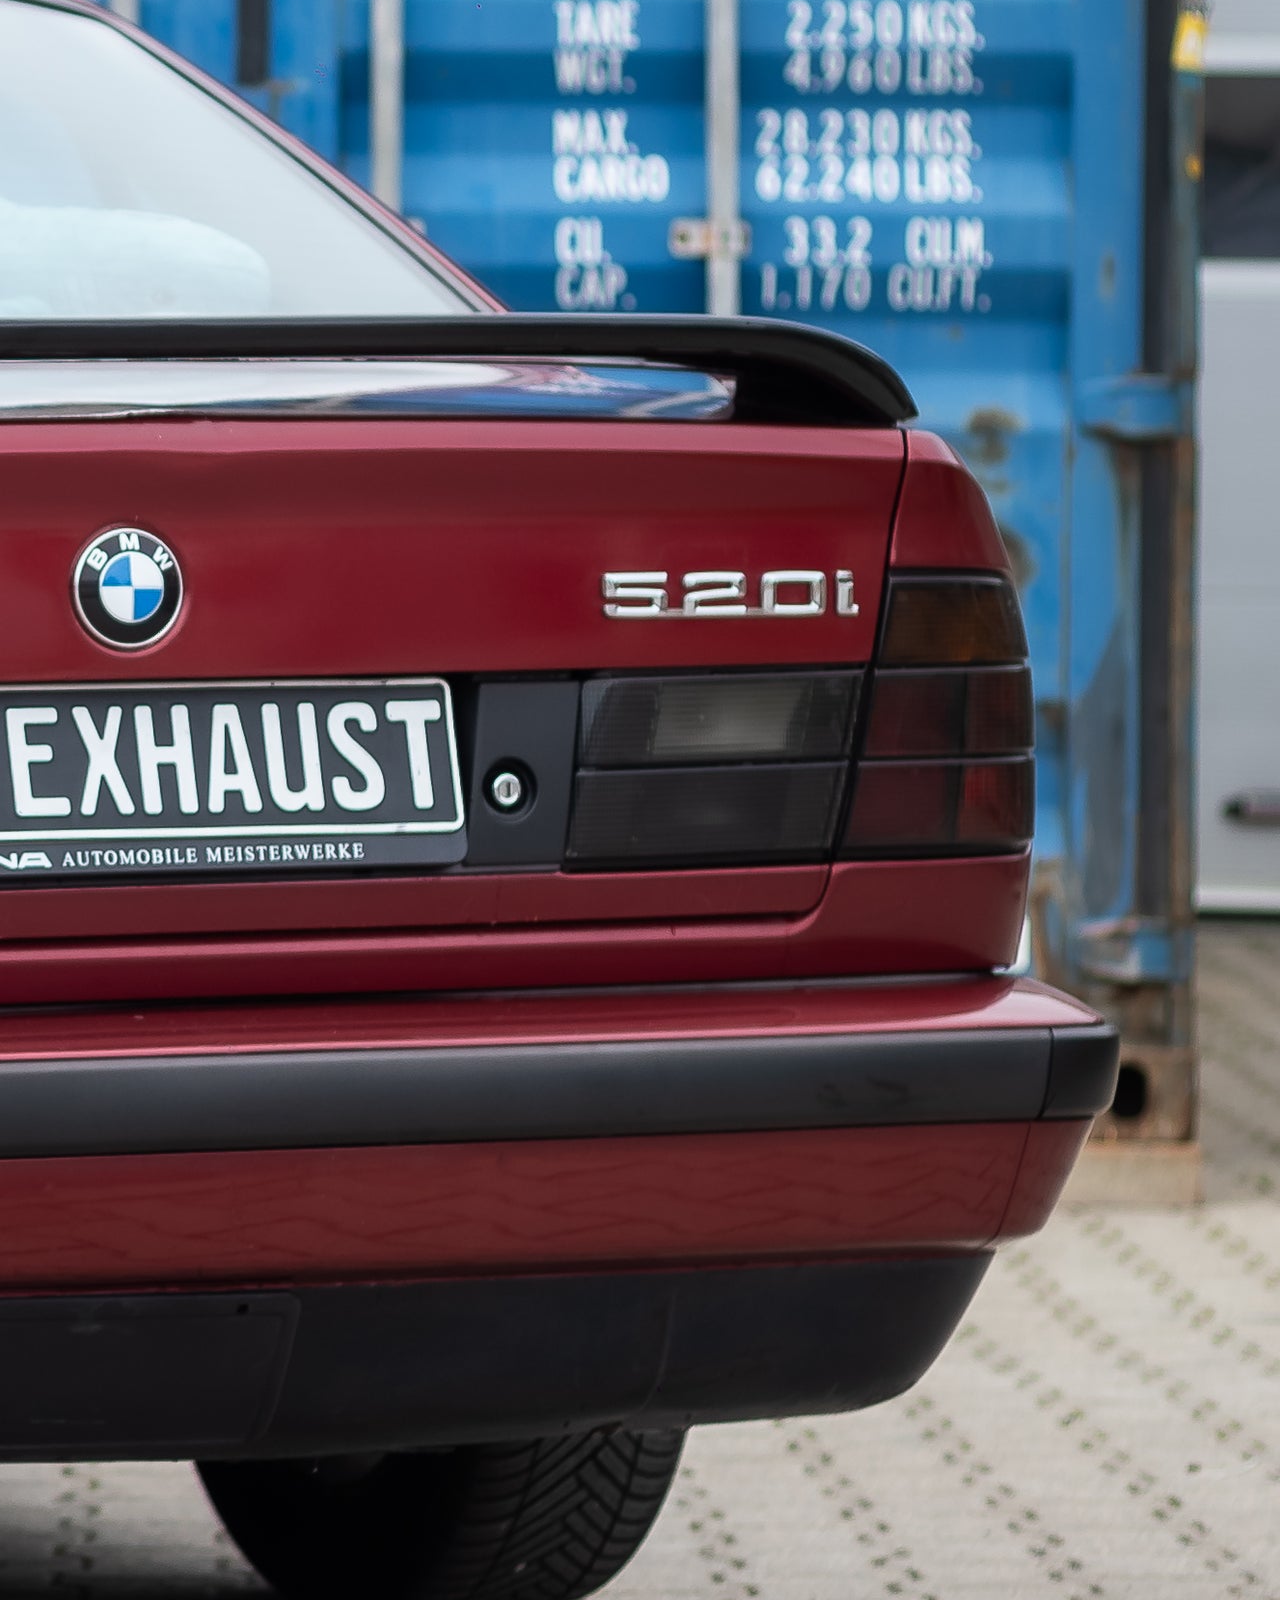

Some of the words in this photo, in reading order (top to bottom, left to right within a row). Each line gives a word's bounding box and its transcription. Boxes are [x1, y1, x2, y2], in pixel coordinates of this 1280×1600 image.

[903, 108, 983, 157] KGS.
[86, 532, 174, 571] BMW
[601, 569, 860, 619] 520i
[5, 699, 442, 818] EXHAUST
[61, 846, 199, 868] AUTOMOBILE
[205, 840, 366, 865] MEISTERWERKE
